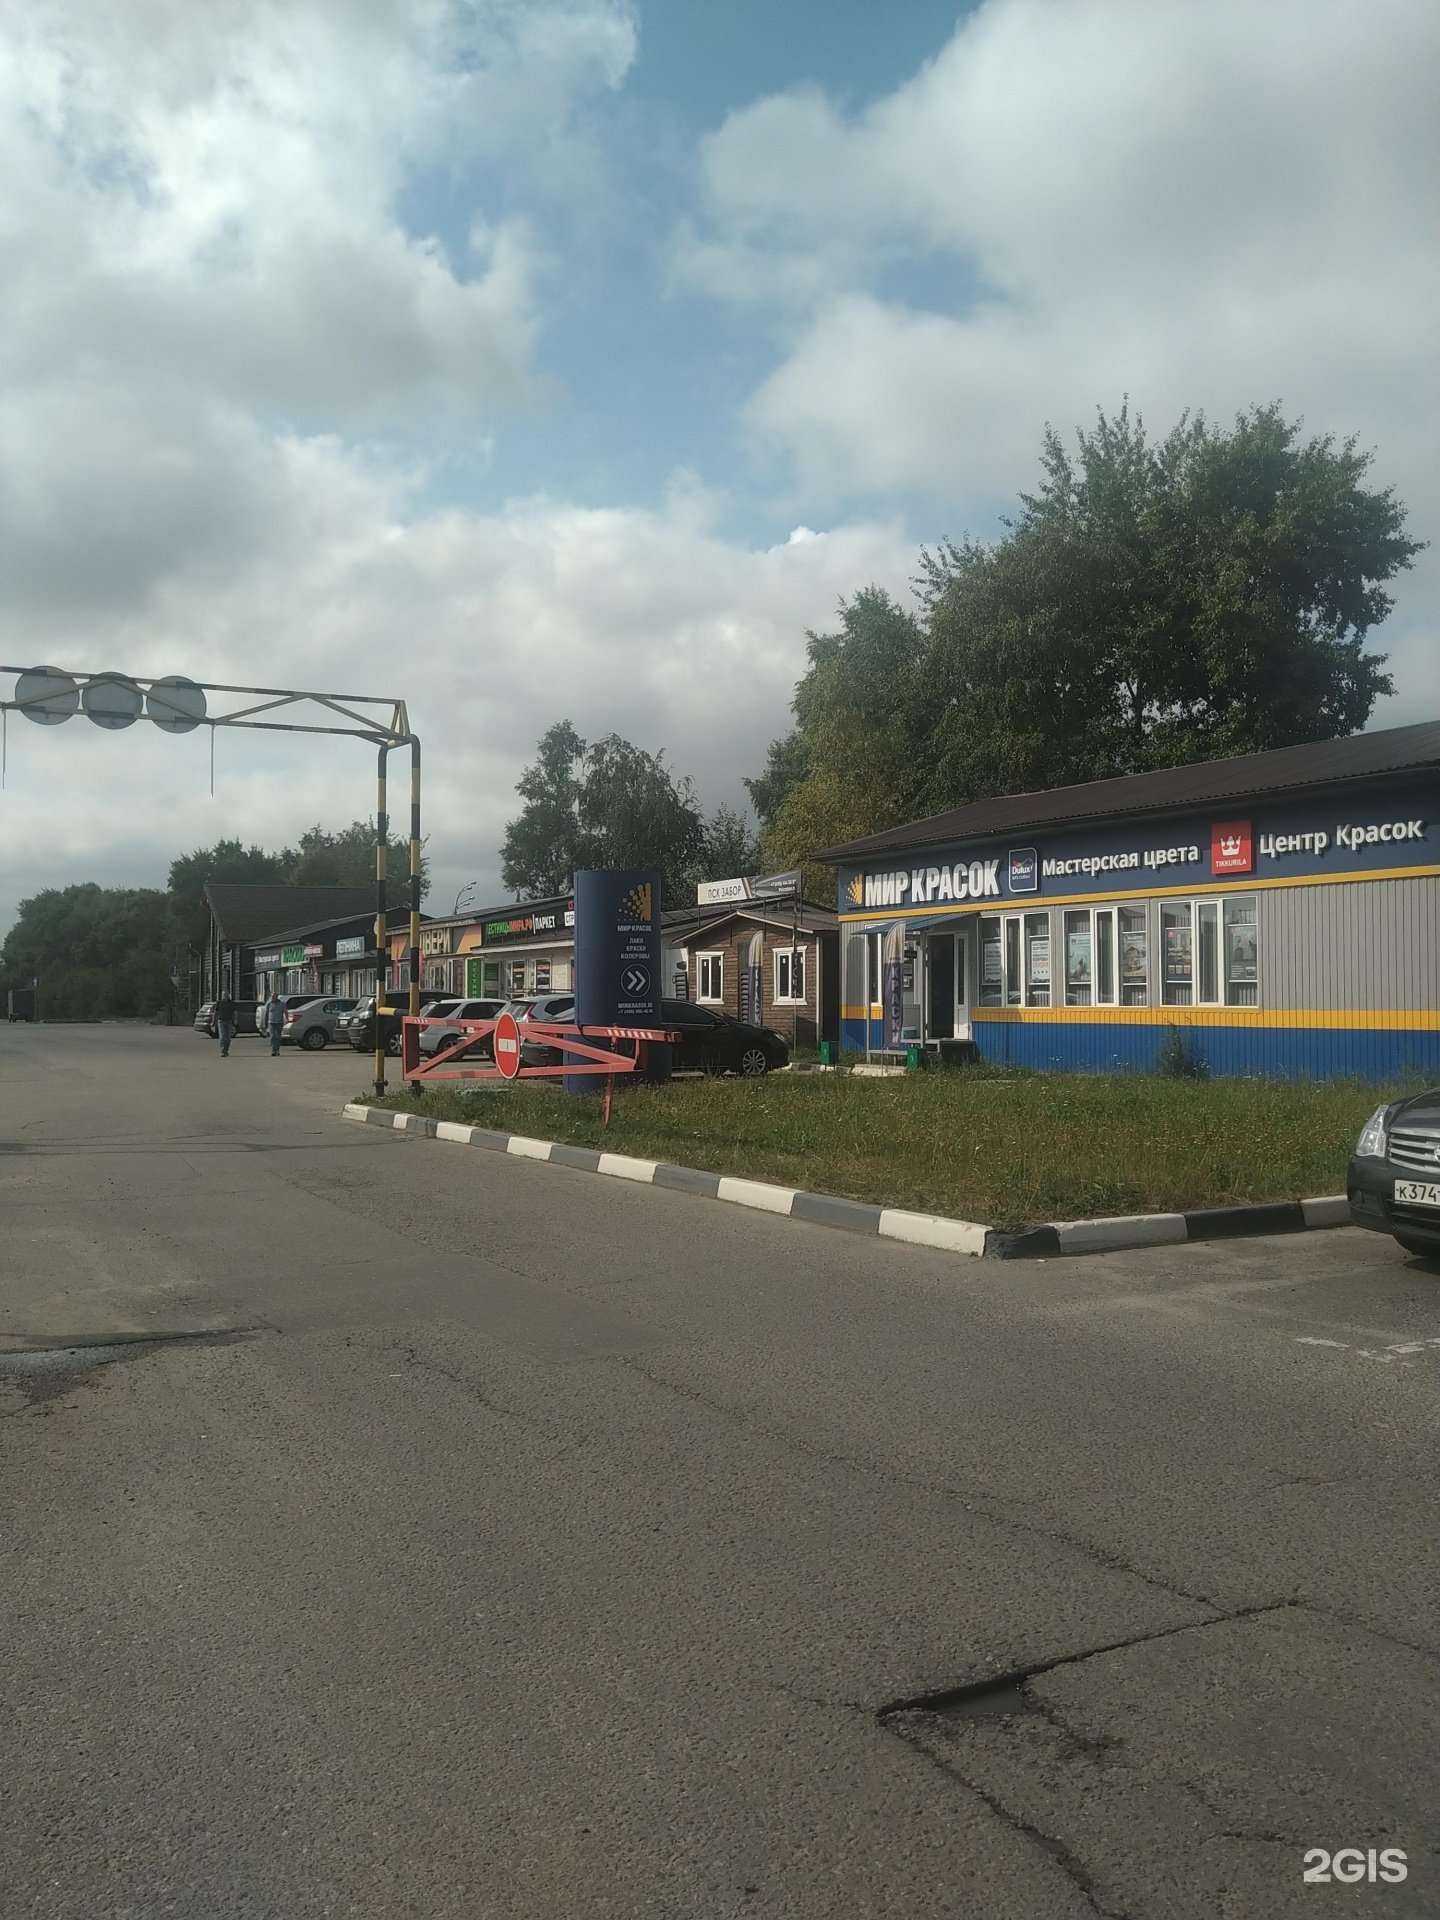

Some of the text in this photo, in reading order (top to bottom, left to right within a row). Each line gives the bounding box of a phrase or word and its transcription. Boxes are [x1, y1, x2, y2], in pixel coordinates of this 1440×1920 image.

[1260, 820, 1424, 858] Центр Красок
[1012, 866, 1031, 875] Dulux
[1042, 845, 1198, 877] Мастерская цвета
[1216, 858, 1247, 868] TIKKURILA
[865, 859, 999, 907] МИР КРАСОК
[1399, 1183, 1440, 1203] К374
